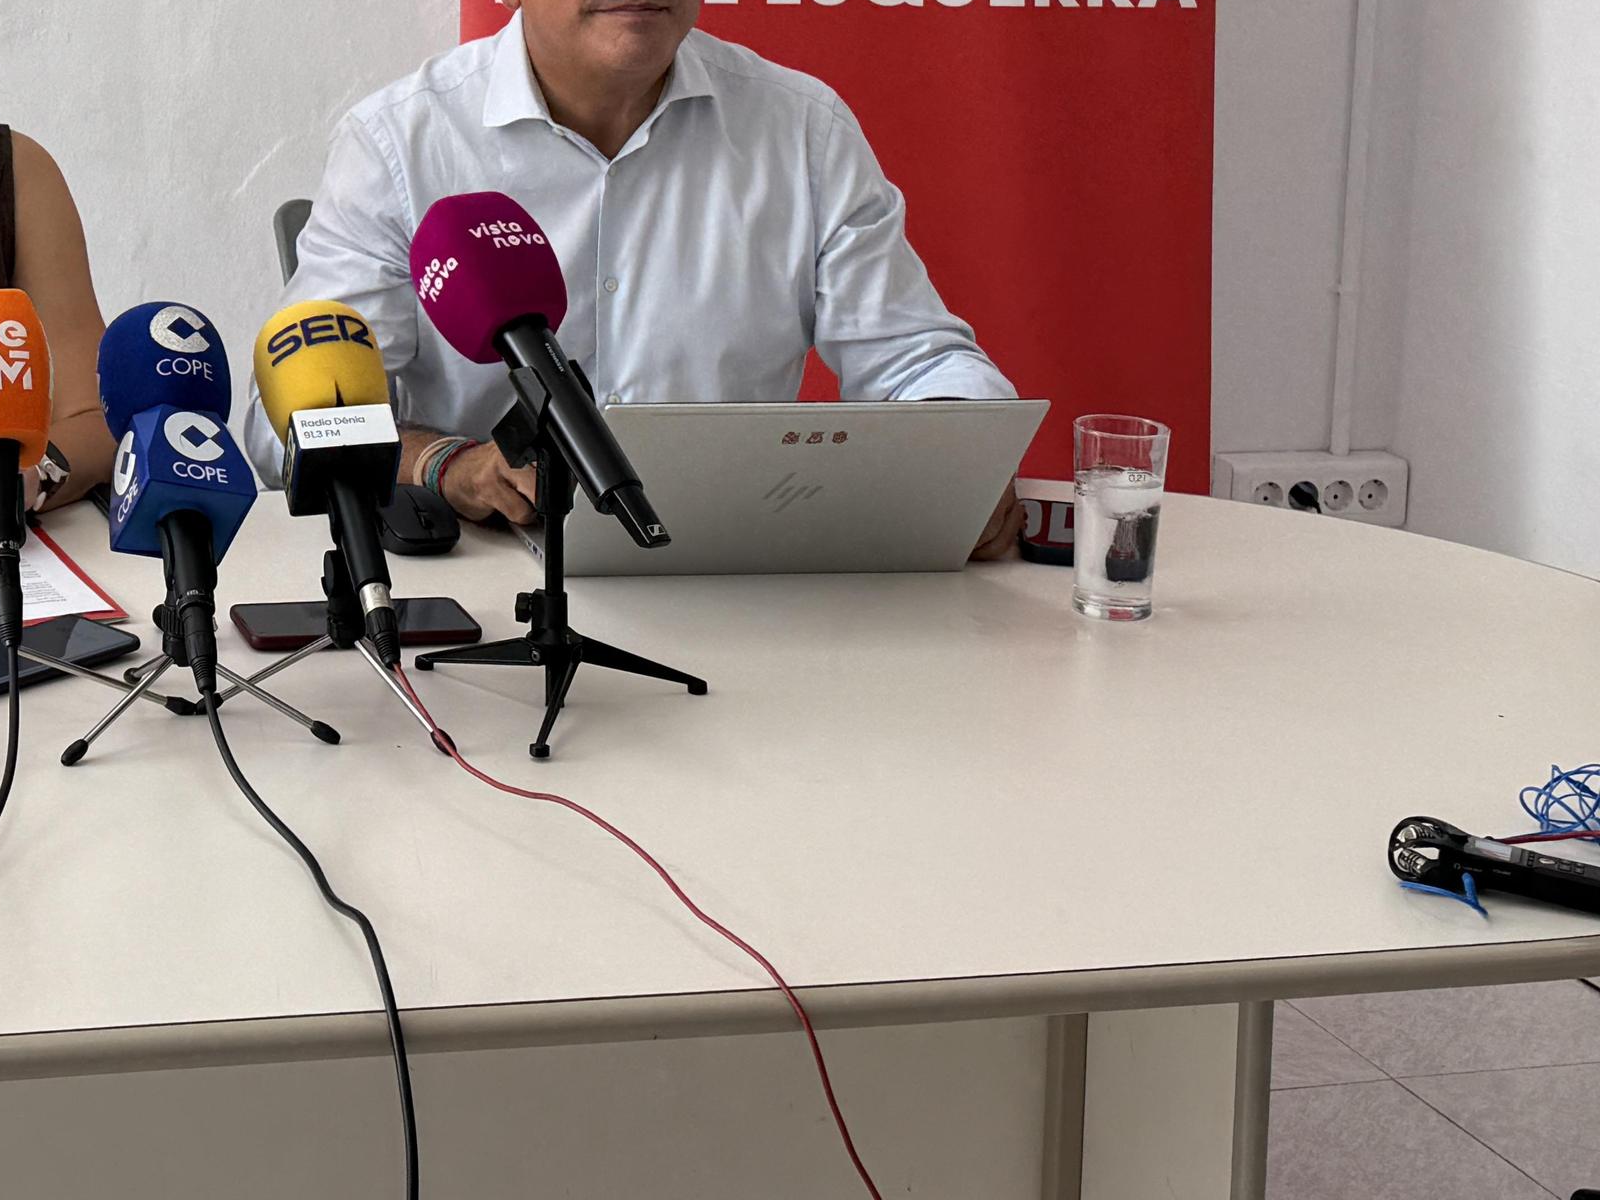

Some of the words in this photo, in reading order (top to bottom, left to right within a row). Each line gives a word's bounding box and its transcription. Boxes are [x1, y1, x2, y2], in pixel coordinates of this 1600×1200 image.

[468, 220, 523, 238] vista
[493, 233, 546, 249] nova
[267, 313, 375, 367] SER
[156, 357, 214, 382] COPE
[300, 417, 332, 428] Radio
[325, 429, 341, 438] FM
[172, 461, 229, 484] COPE
